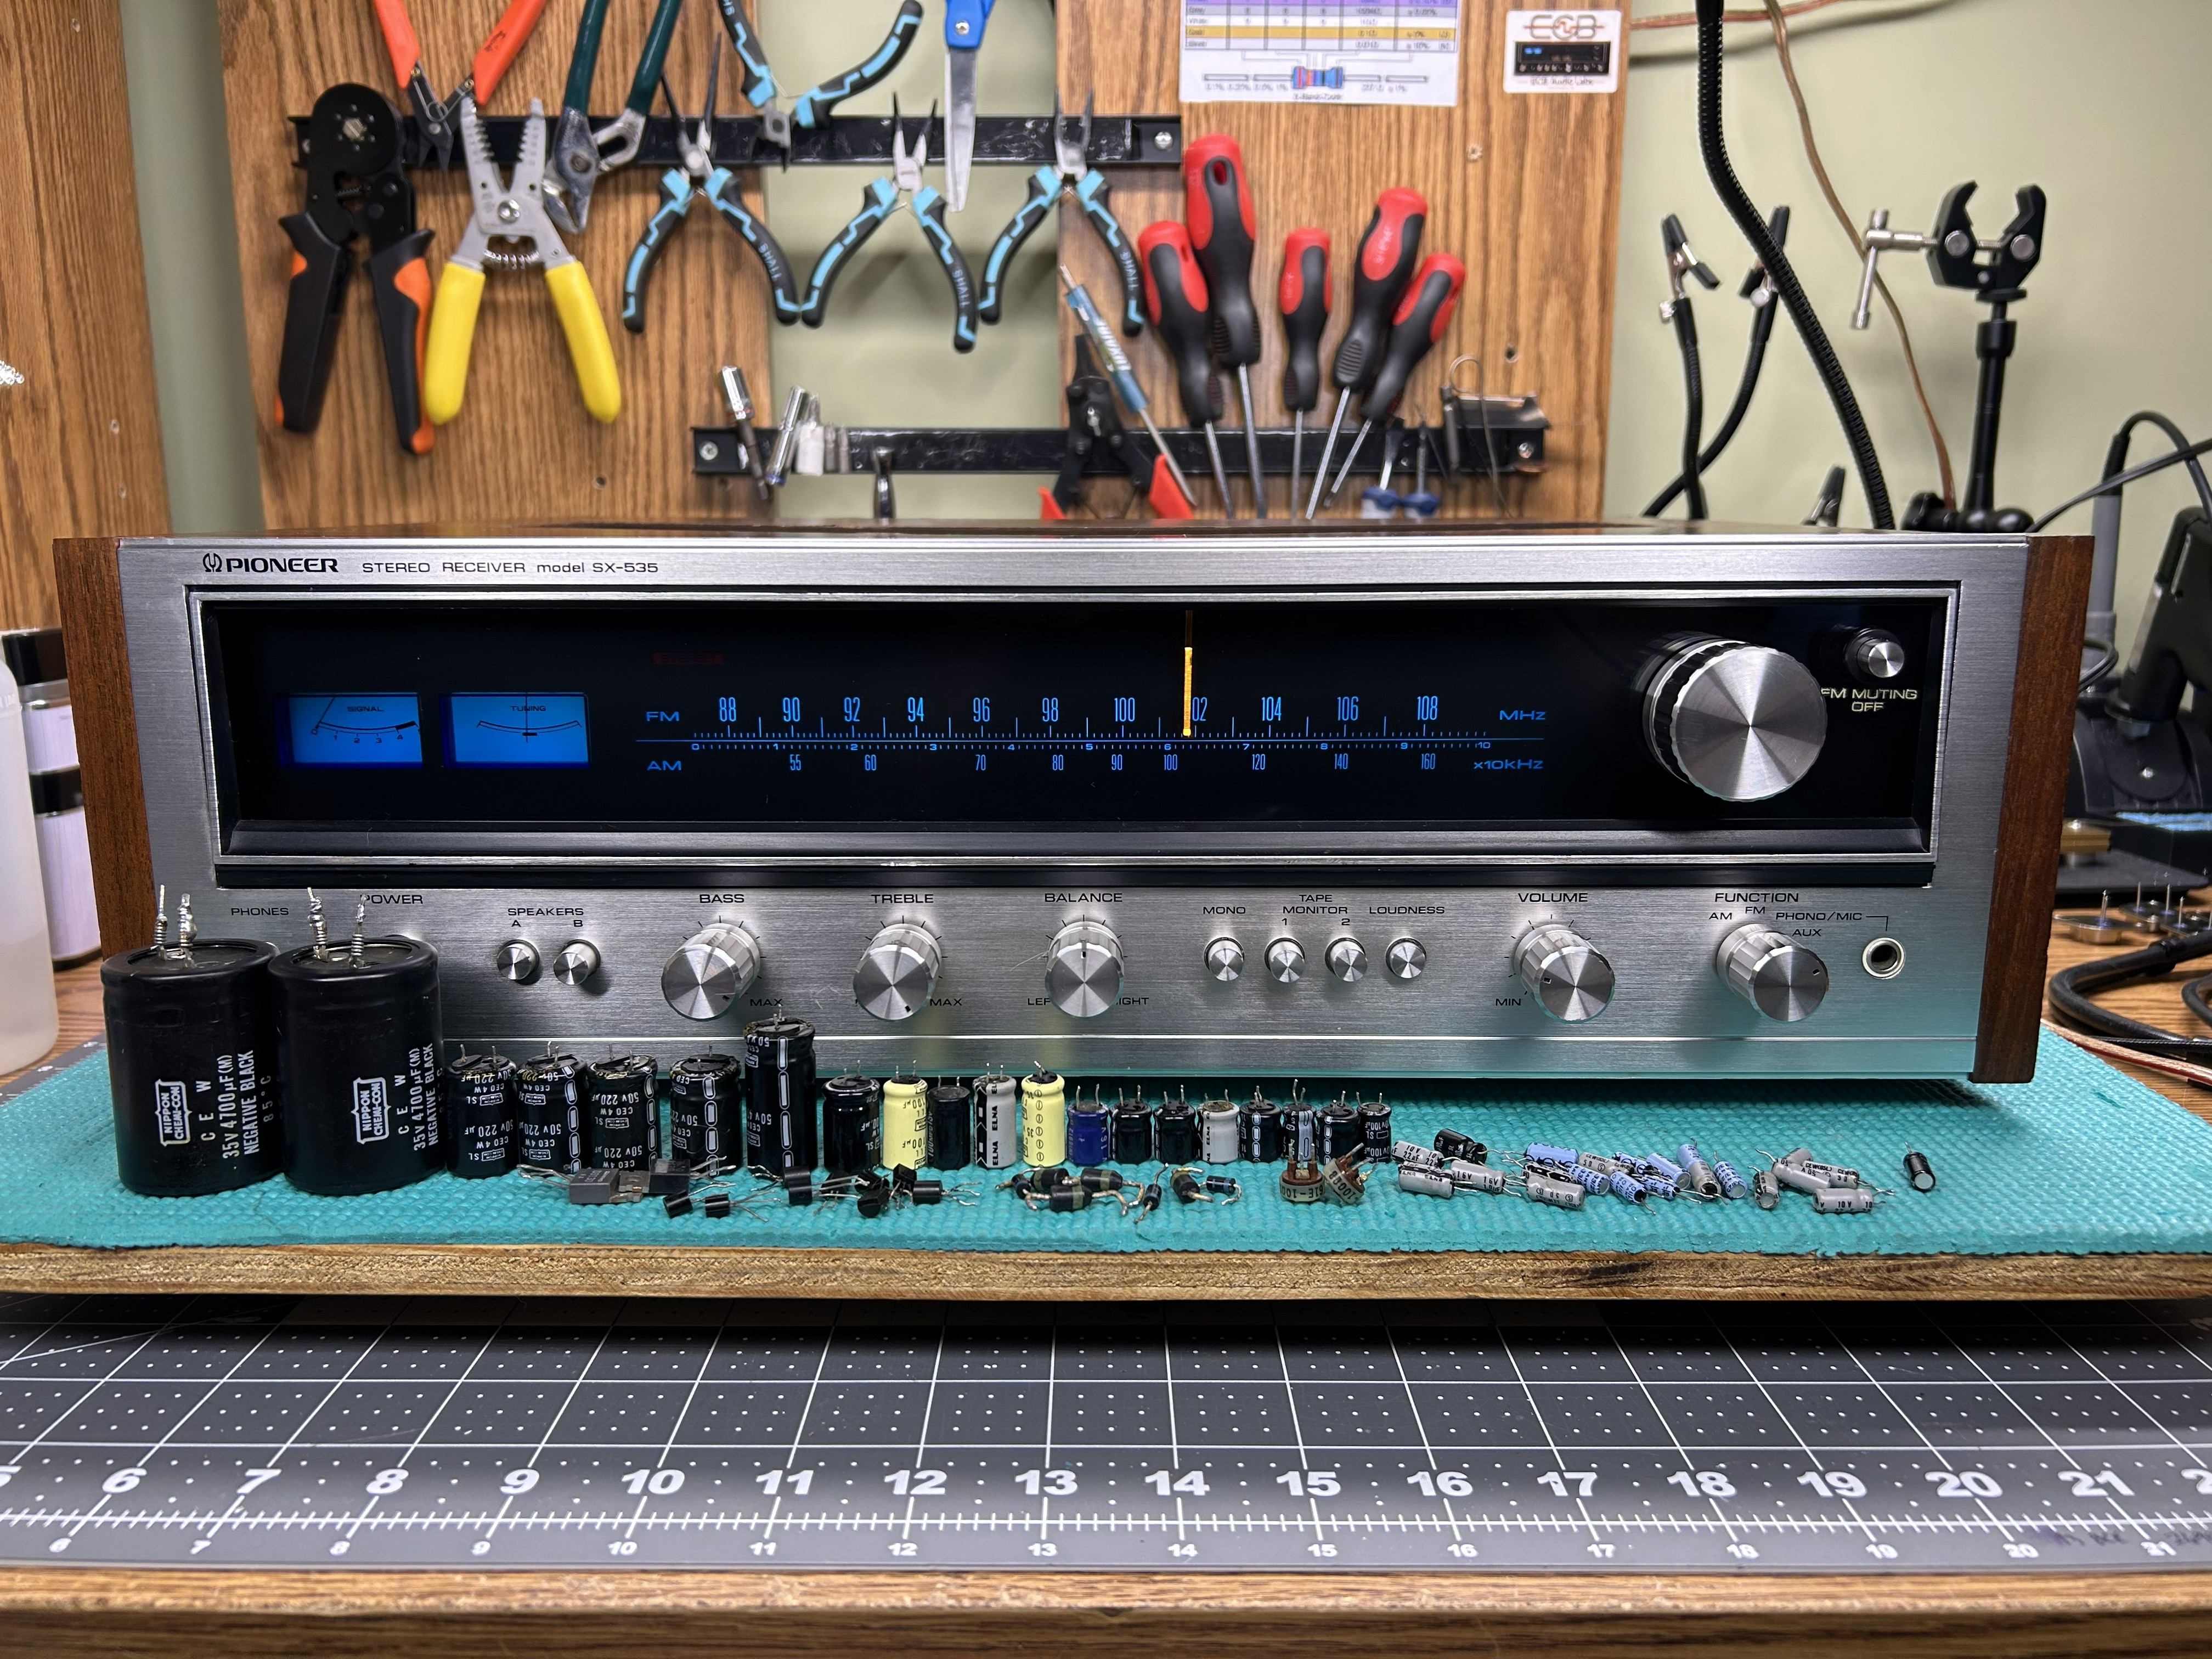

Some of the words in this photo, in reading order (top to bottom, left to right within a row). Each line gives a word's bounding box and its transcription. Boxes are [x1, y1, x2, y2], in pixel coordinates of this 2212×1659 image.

[226, 558, 338, 573] PIONEER
[362, 562, 430, 573] STEREO
[442, 562, 526, 573] RECEIVER
[537, 561, 585, 573] model
[592, 562, 659, 573] SX-535
[1821, 687, 1846, 698] FM
[1852, 689, 1917, 699] MUTING
[646, 712, 680, 721] FM
[719, 697, 737, 722] 88
[783, 697, 800, 722] 90
[844, 697, 860, 722] 92
[907, 697, 924, 722] 94
[973, 697, 990, 722] 96
[1042, 697, 1059, 722] 98
[1114, 697, 1136, 722] 100
[1191, 697, 1207, 722] 02
[1261, 697, 1282, 722] 104
[1337, 697, 1358, 722] 106
[1417, 696, 1438, 721] 108
[1499, 710, 1546, 720] MHz
[1852, 702, 1884, 712] OFF
[647, 761, 681, 771] AM
[790, 755, 801, 770] 55
[865, 755, 877, 770] 60
[975, 755, 986, 770] 70
[1052, 755, 1064, 770] 80
[1111, 754, 1123, 770] 90
[1164, 754, 1178, 770] 100
[1252, 754, 1266, 770] 120
[1334, 754, 1348, 770] 140
[1421, 754, 1435, 770] 160
[1474, 759, 1543, 769] x10kHz
[699, 894, 744, 904] BASS
[871, 894, 934, 904] TREBLE
[1045, 893, 1123, 902] BALANCE
[1518, 893, 1588, 902] VOLUME
[1714, 893, 1799, 902] FUNCTION
[1283, 906, 1348, 915] MONITOR
[1369, 906, 1445, 915] LOUDNESS
[1775, 912, 1862, 921] PHONO/MIC
[749, 998, 783, 1006] MAX
[929, 998, 962, 1006] MAX
[423, 1043, 434, 1084] BLACK
[238, 1050, 255, 1091] BLACK
[161, 1092, 173, 1133] NIPPON
[171, 1086, 184, 1140] CHEMI-CON
[362, 1090, 371, 1131] NIPPON
[370, 1082, 383, 1136] CHEMI-CON
[426, 1087, 438, 1146] NEGATIVE
[240, 1096, 260, 1155] NEGATIVE
[478, 1125, 496, 1136] 220
[1280, 1185, 1323, 1198] 61E-100
[102, 1468, 147, 1493] 6
[236, 1469, 282, 1493] 7
[366, 1469, 409, 1494] 8
[500, 1469, 540, 1494] 9
[621, 1469, 685, 1495] 10
[755, 1469, 815, 1495] 11
[884, 1469, 947, 1496] 12
[1014, 1469, 1079, 1496] 13
[1144, 1470, 1210, 1496] 14
[1276, 1471, 1342, 1497] 15
[1407, 1471, 1474, 1497] 16
[1537, 1471, 1599, 1497] 17
[1667, 1471, 1737, 1497] 18
[1796, 1471, 1866, 1497] 19
[1925, 1471, 2003, 1498] 20
[2057, 1470, 2135, 1497] 21
[2181, 1468, 2212, 1493] 2
[189, 1539, 212, 1554] 7
[329, 1539, 351, 1555] 8
[471, 1539, 492, 1556] 9
[608, 1541, 638, 1556] 10
[749, 1542, 777, 1556] 11
[888, 1542, 918, 1556] 12
[1028, 1542, 1058, 1556] 13
[1168, 1543, 1198, 1557] 14
[1307, 1543, 1338, 1558] 15
[1447, 1543, 1478, 1558] 16
[1587, 1543, 1617, 1558] 17
[1726, 1543, 1759, 1559] 18
[2003, 1542, 2039, 1559] 20
[2140, 1541, 2177, 1557] 21
